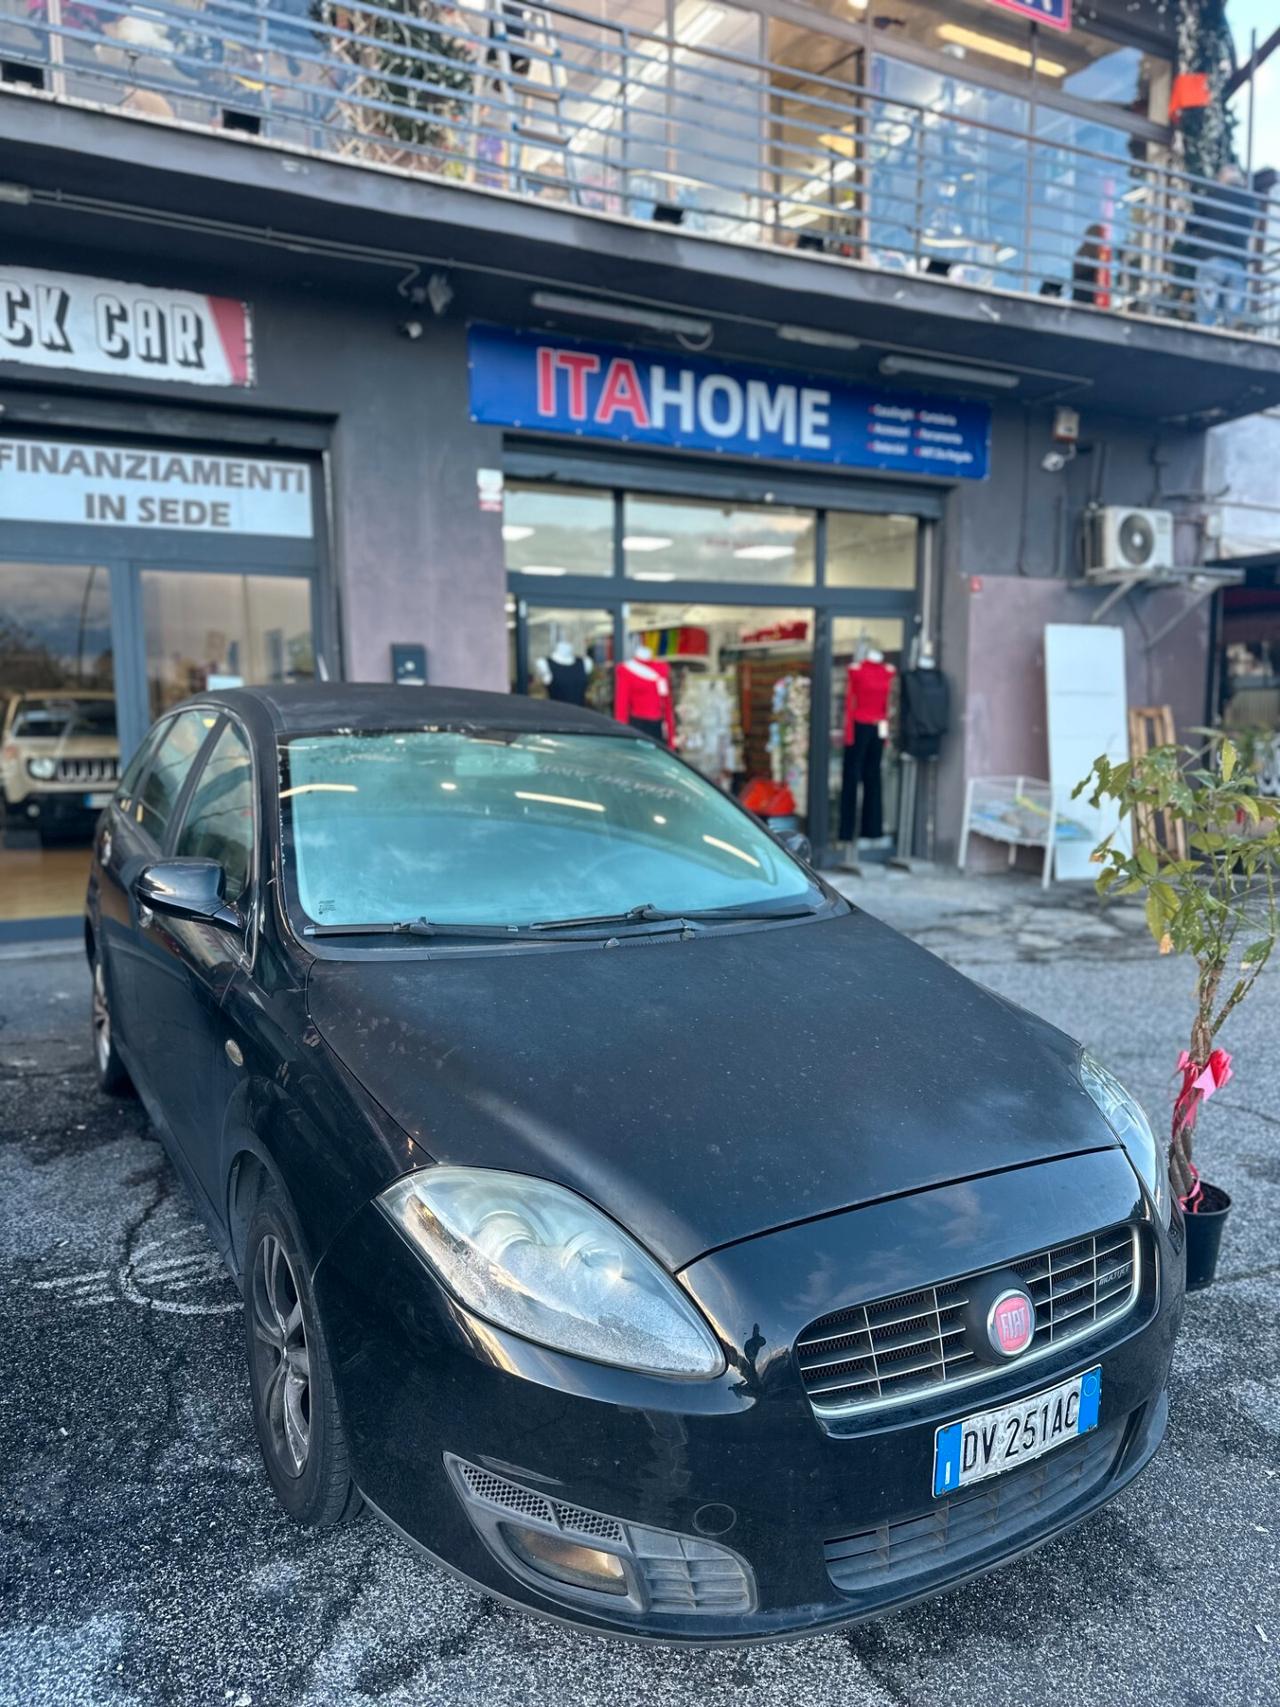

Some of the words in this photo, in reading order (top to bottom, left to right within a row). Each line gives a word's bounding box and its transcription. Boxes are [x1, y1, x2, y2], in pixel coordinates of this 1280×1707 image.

[94, 293, 206, 370] CAR
[536, 346, 832, 450] ITAHOME
[0, 443, 305, 493] FINANZIAMENTI
[85, 493, 126, 522] IN
[138, 497, 231, 528] SEDE
[1000, 1307, 1026, 1341] FIAT
[962, 1422, 997, 1474] DV
[1004, 1391, 1080, 1460] 251AC
